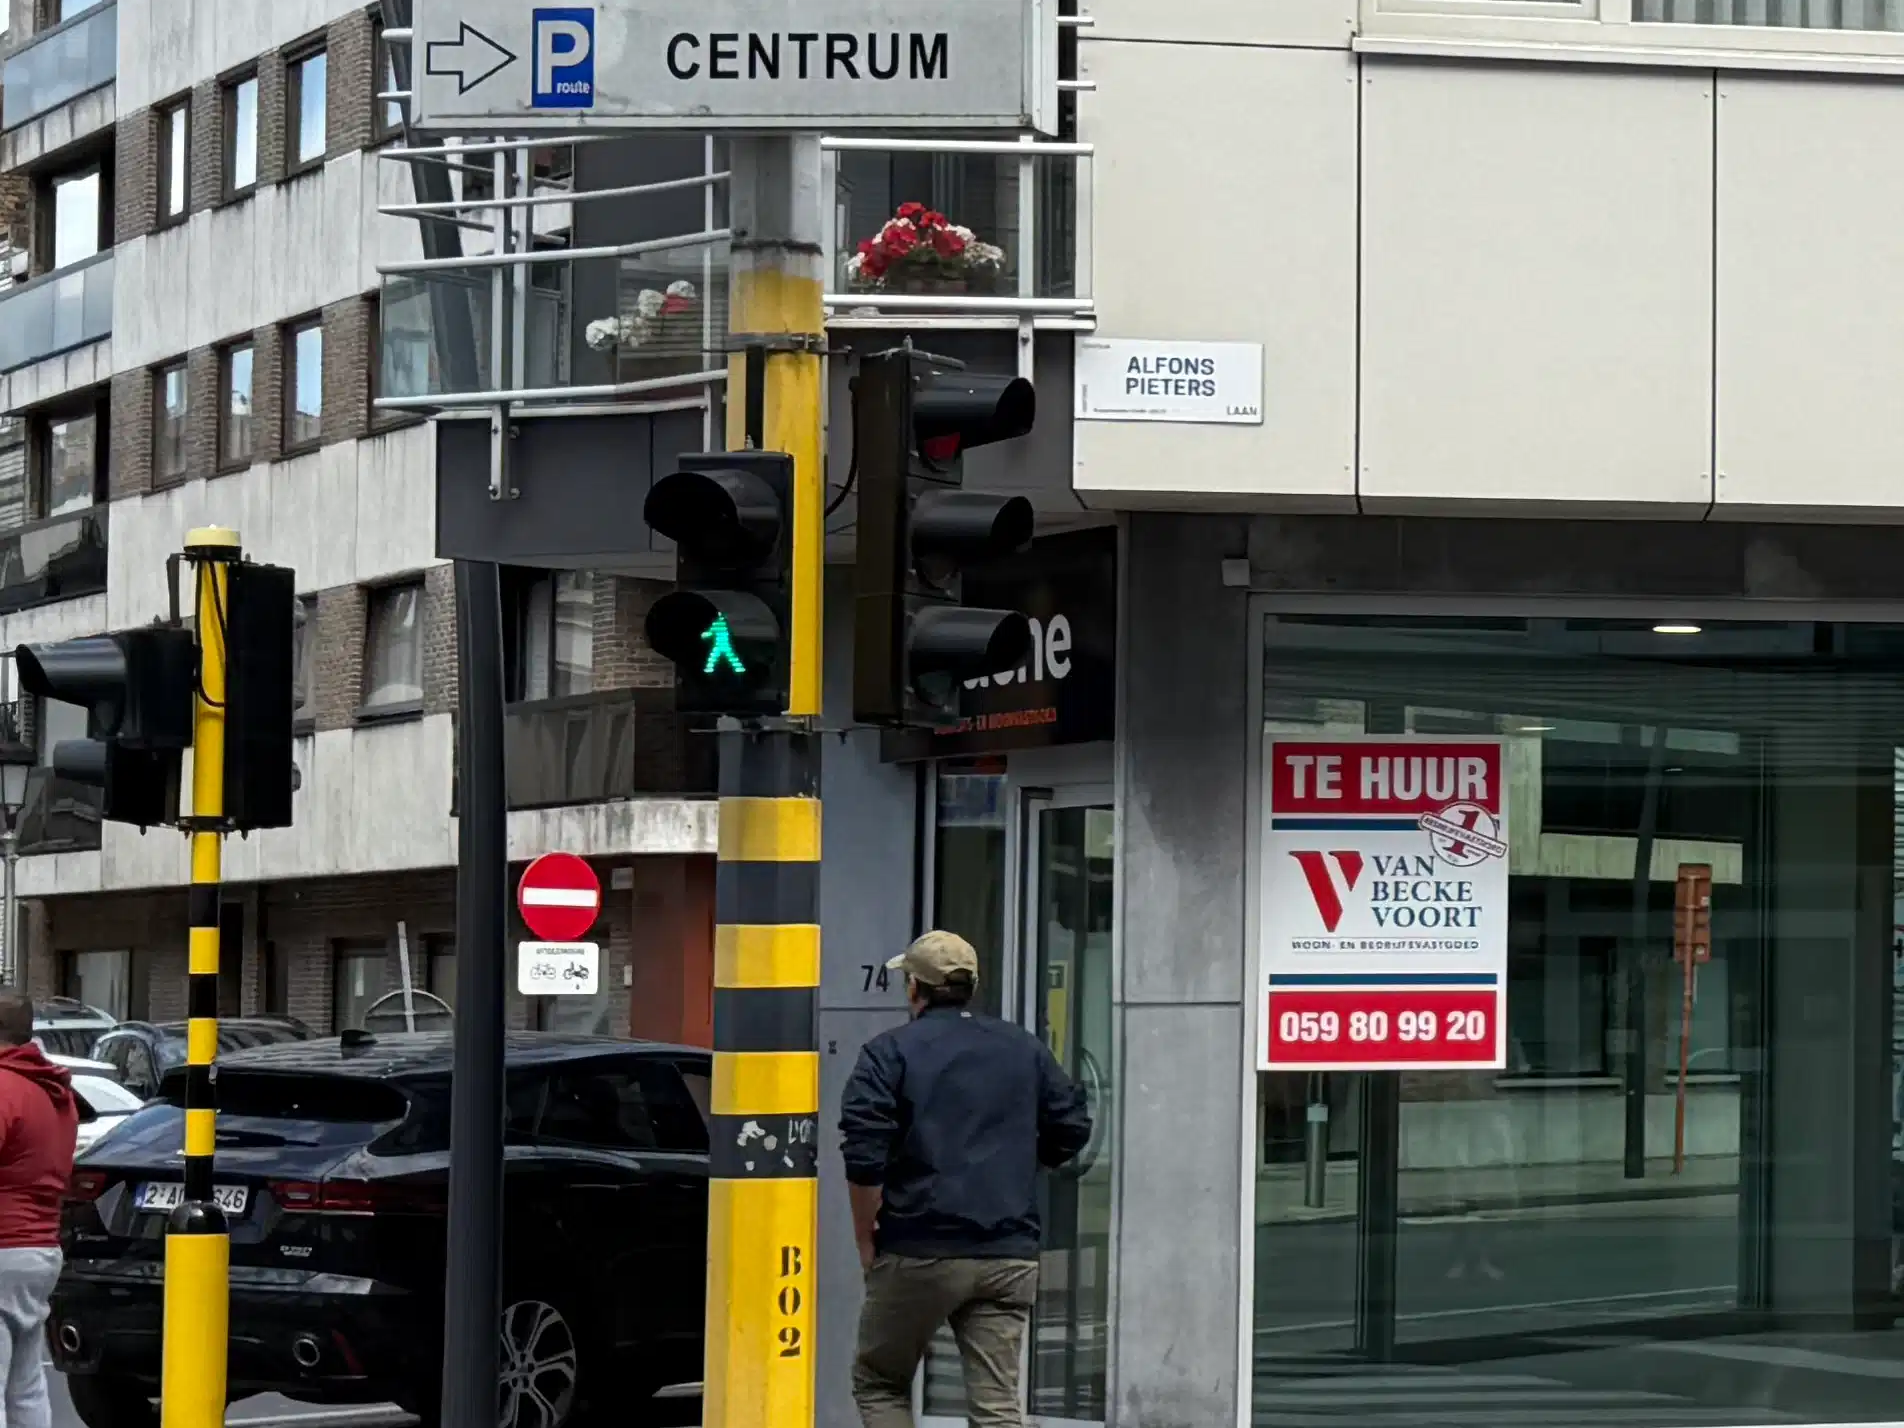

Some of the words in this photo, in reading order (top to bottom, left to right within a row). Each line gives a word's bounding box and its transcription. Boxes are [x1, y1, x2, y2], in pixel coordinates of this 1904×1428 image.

[537, 20, 590, 94] P
[667, 32, 948, 80] CENTRUM
[556, 80, 590, 94] route
[1127, 356, 1215, 375] ALFONS
[1126, 378, 1216, 397] PIETERS
[1226, 406, 1257, 416] LAAN
[1286, 755, 1343, 799] TE
[1360, 756, 1489, 801] HUUR
[1372, 855, 1436, 876] VAN
[1371, 880, 1473, 902] BECKE
[1371, 906, 1483, 928] VOORT
[1340, 941, 1356, 950] EN
[861, 964, 890, 992] 74
[1279, 1010, 1340, 1042] 059
[1349, 1010, 1389, 1042] 80
[1398, 1010, 1438, 1042] 99
[1446, 1009, 1486, 1041] 20
